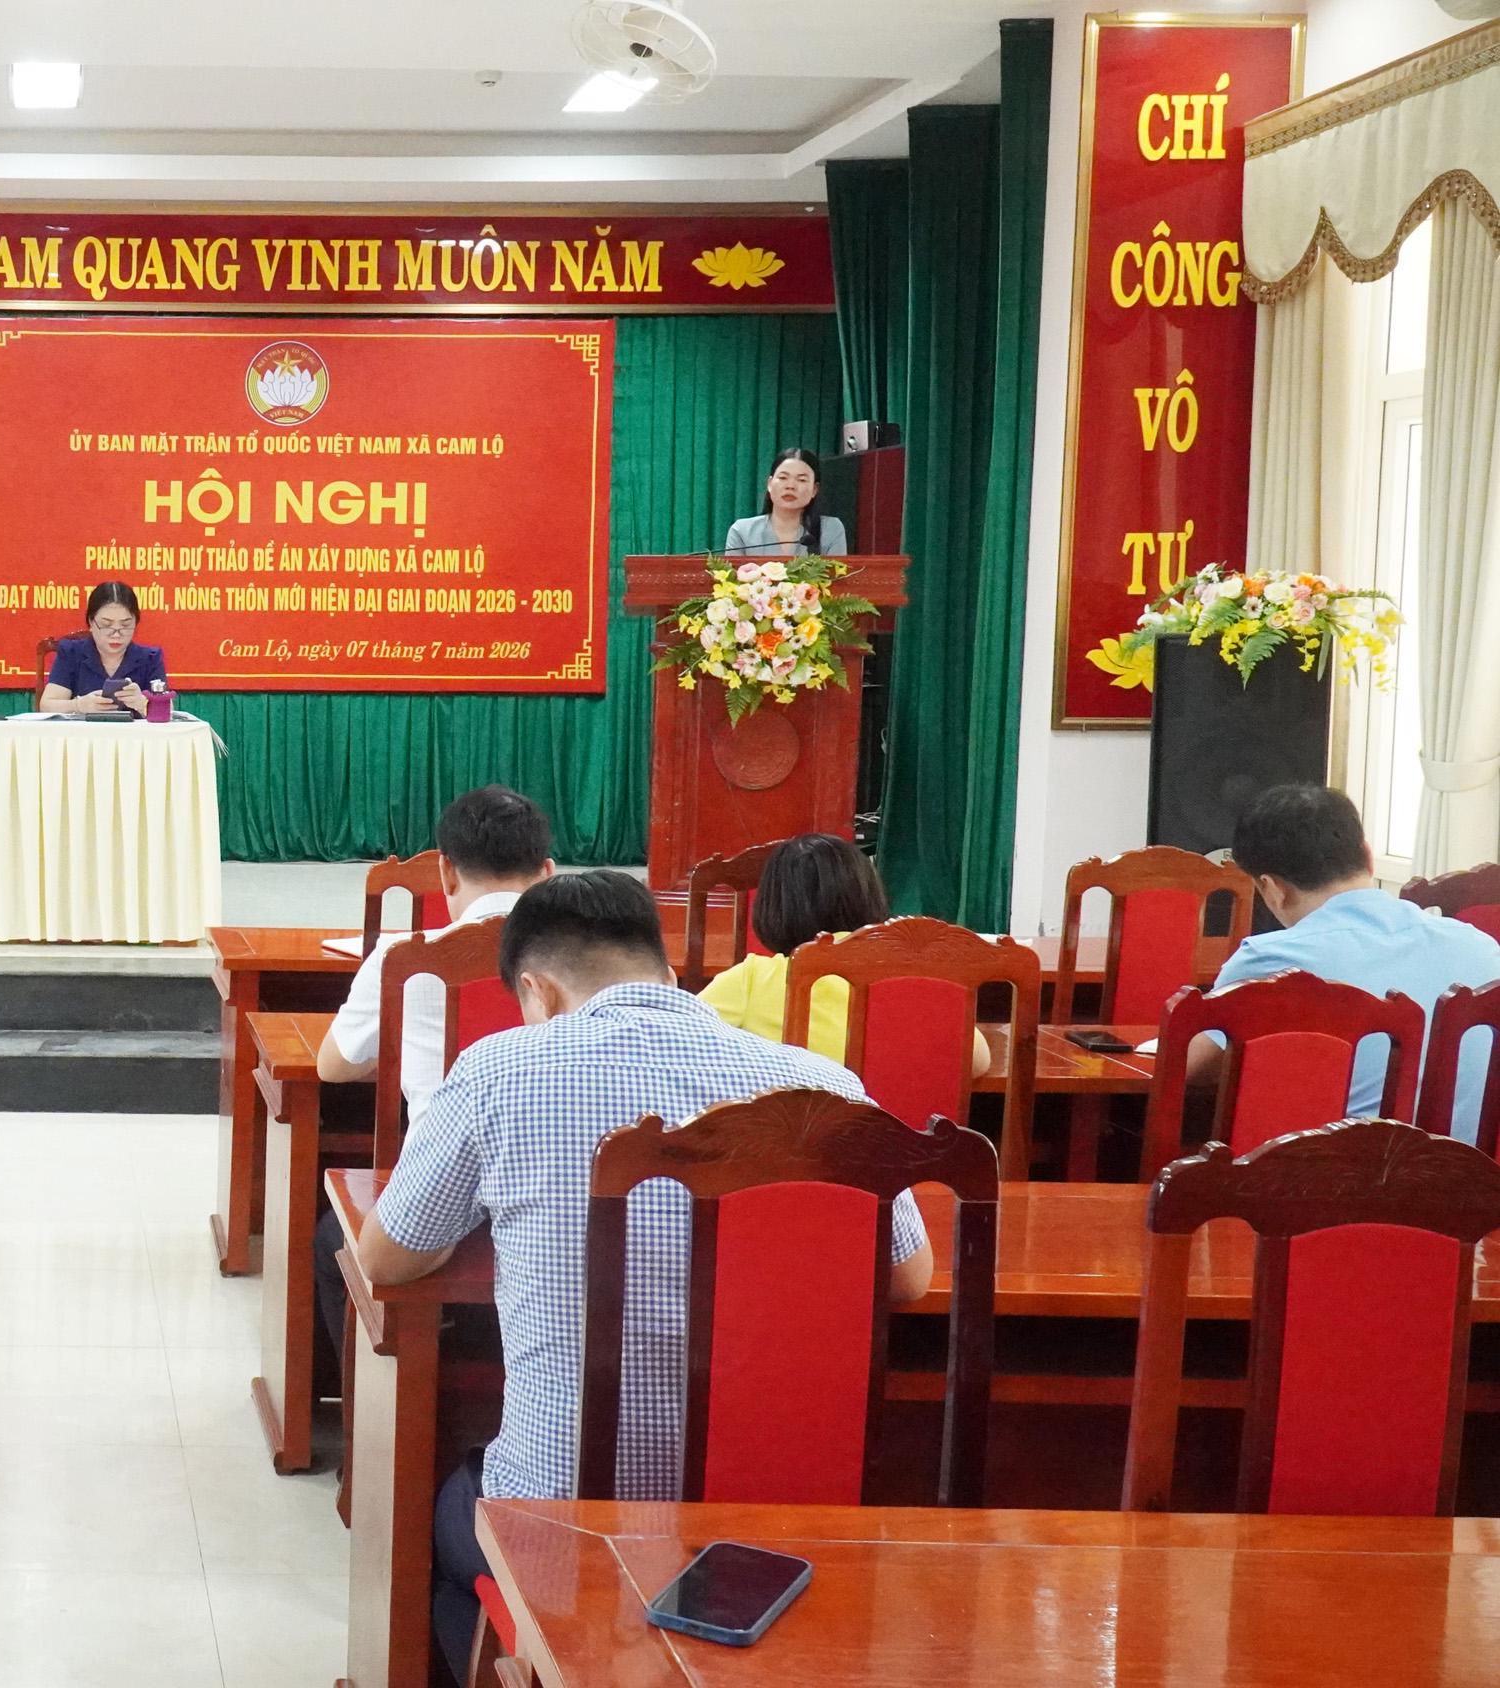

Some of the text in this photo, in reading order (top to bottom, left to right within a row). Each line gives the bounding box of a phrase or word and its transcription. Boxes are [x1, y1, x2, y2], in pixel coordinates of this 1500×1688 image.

[1137, 72, 1230, 162] CHÍ
[72, 236, 241, 301] QUANG
[251, 238, 382, 292] VINH
[394, 224, 541, 293] MUÔN
[550, 225, 664, 293] NĂM
[1110, 220, 1242, 308] CÔNG
[70, 429, 504, 458] ỦY BAN MẶT TRẬN TỔ QUỐC VIỆT NAM XÃ CAM LỘ
[1133, 368, 1199, 453] VÔ
[144, 467, 427, 538] HỘI NGHỊ
[86, 538, 485, 578] PHẢN BIỆN DỰ THẢO ĐỀ ÁN XÂY DỰNG XÃ CAM LỘ
[1122, 519, 1195, 595] TƯ
[34, 580, 80, 610] NÔNG
[132, 582, 169, 614] MỚI,
[174, 582, 221, 611] NÔNG
[225, 582, 269, 612] THÔN
[274, 582, 305, 612] MỚI
[311, 583, 349, 617] HIỆN
[354, 588, 382, 617] ĐẠI
[387, 588, 420, 612] GIAI
[425, 588, 471, 618] ĐOẠN
[475, 589, 516, 613] 2026
[532, 589, 573, 613] 2030
[219, 639, 532, 662] Cam Lộ, ngày 07 tháng 7 năm 2026
